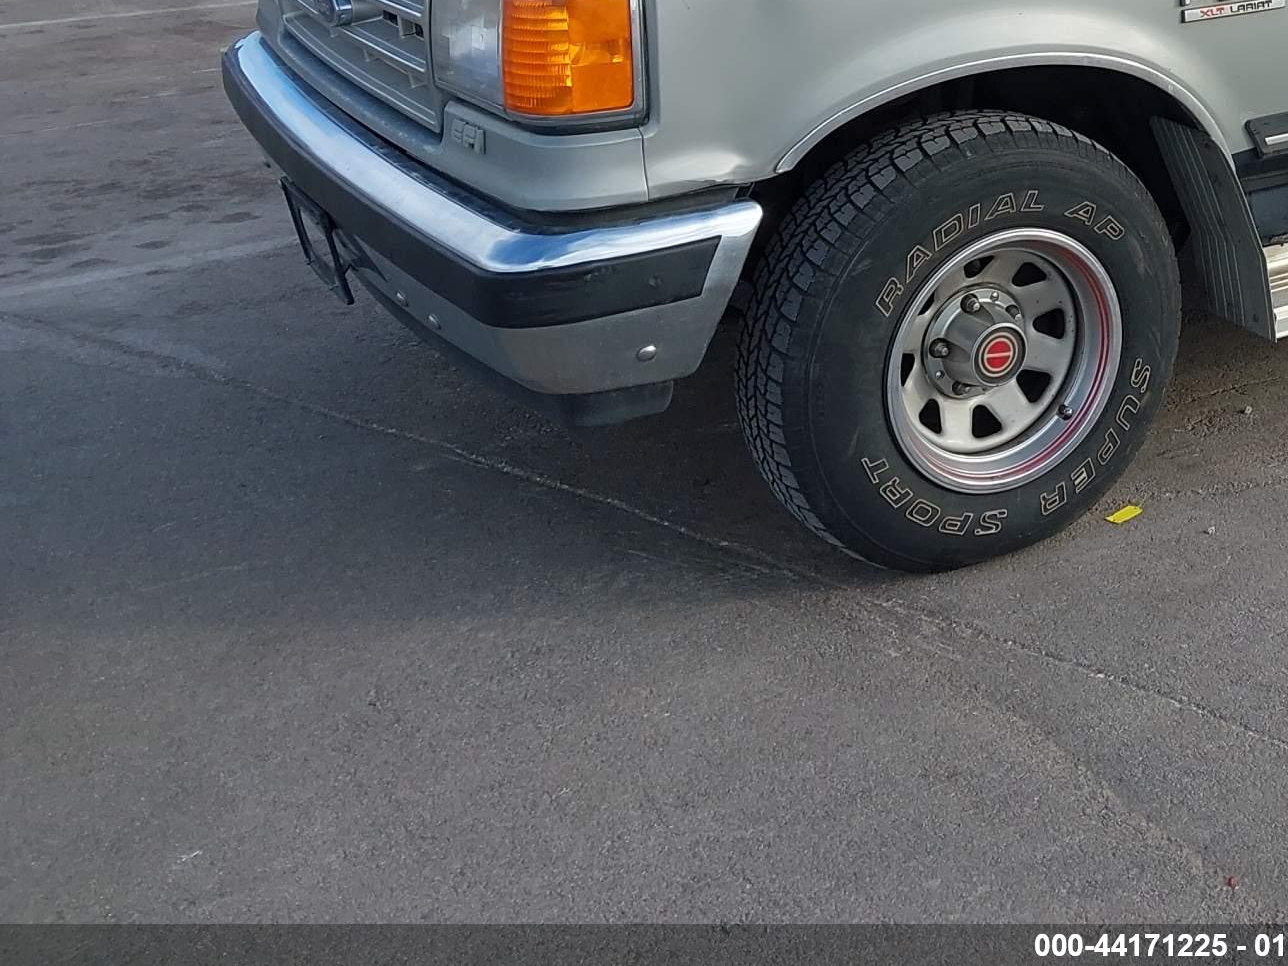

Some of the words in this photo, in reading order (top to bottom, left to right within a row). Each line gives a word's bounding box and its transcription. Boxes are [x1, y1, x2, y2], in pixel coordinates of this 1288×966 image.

[1200, 7, 1225, 18] XLT
[1230, 0, 1273, 13] LARIAT
[875, 190, 1045, 317] RADIAL
[1064, 201, 1125, 240] AP
[1041, 358, 1151, 516] SUPER
[861, 457, 1008, 535] SPORT
